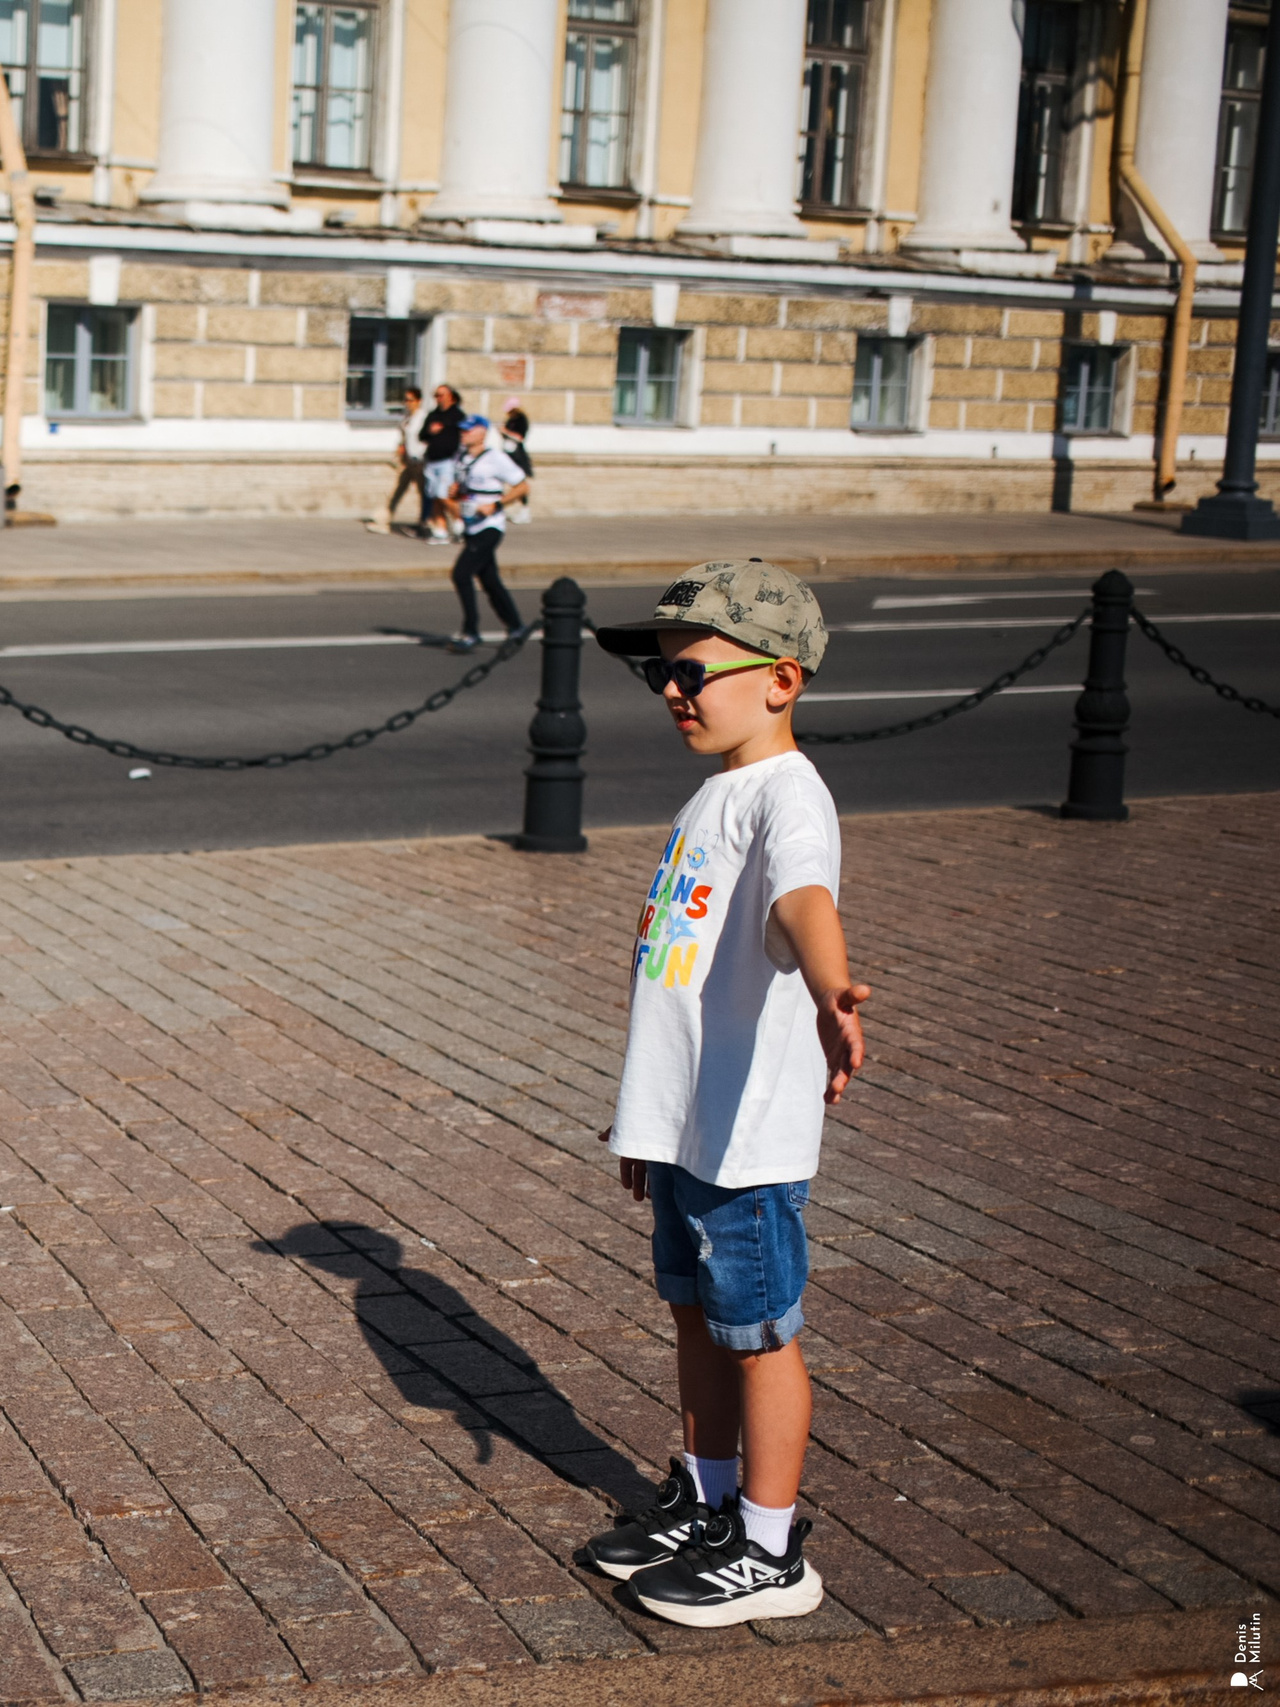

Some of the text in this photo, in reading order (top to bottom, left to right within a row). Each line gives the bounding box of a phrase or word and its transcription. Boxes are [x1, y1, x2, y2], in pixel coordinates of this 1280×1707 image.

[648, 868, 713, 920] LANS
[638, 904, 669, 941] RE
[634, 943, 700, 989] FUN
